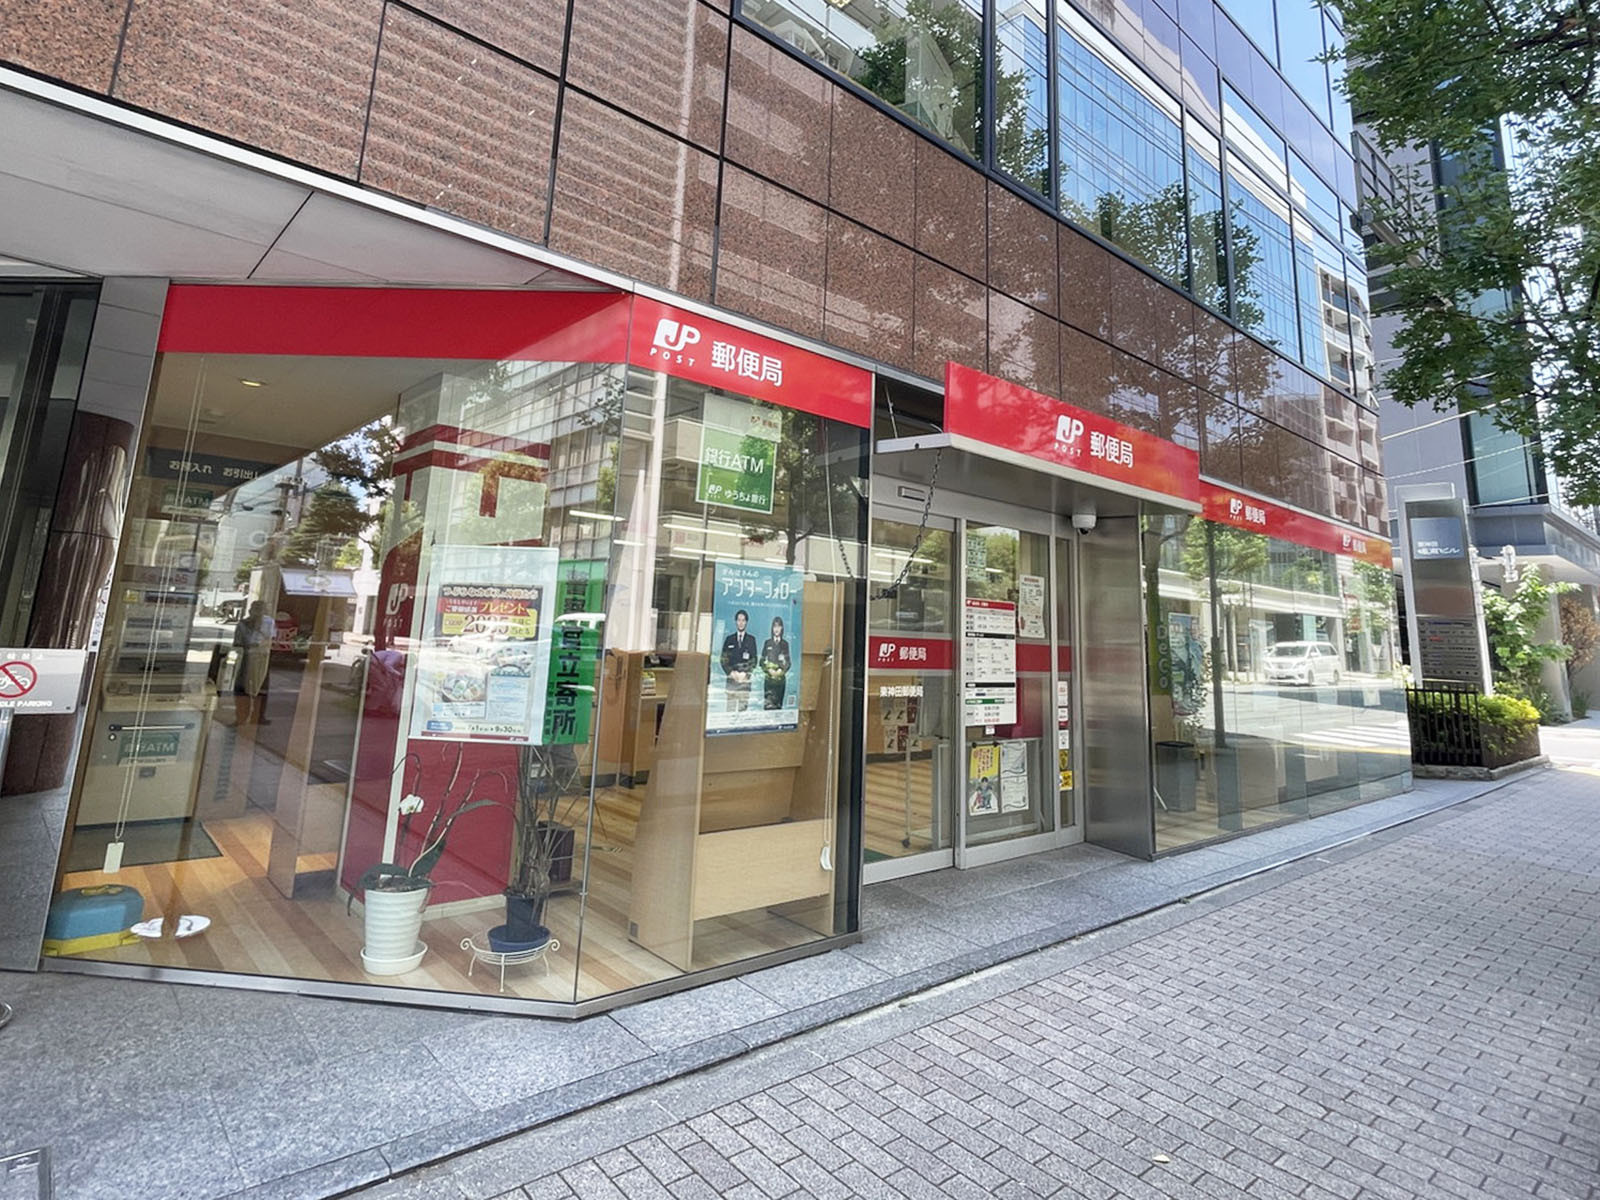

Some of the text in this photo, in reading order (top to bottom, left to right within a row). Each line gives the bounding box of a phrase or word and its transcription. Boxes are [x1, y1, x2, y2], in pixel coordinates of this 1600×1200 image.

[650, 347, 696, 367] POST
[711, 340, 783, 387] 郵便局
[1053, 442, 1082, 457] POST
[1090, 431, 1134, 469] 郵便局
[721, 577, 798, 600] アフターフォロー
